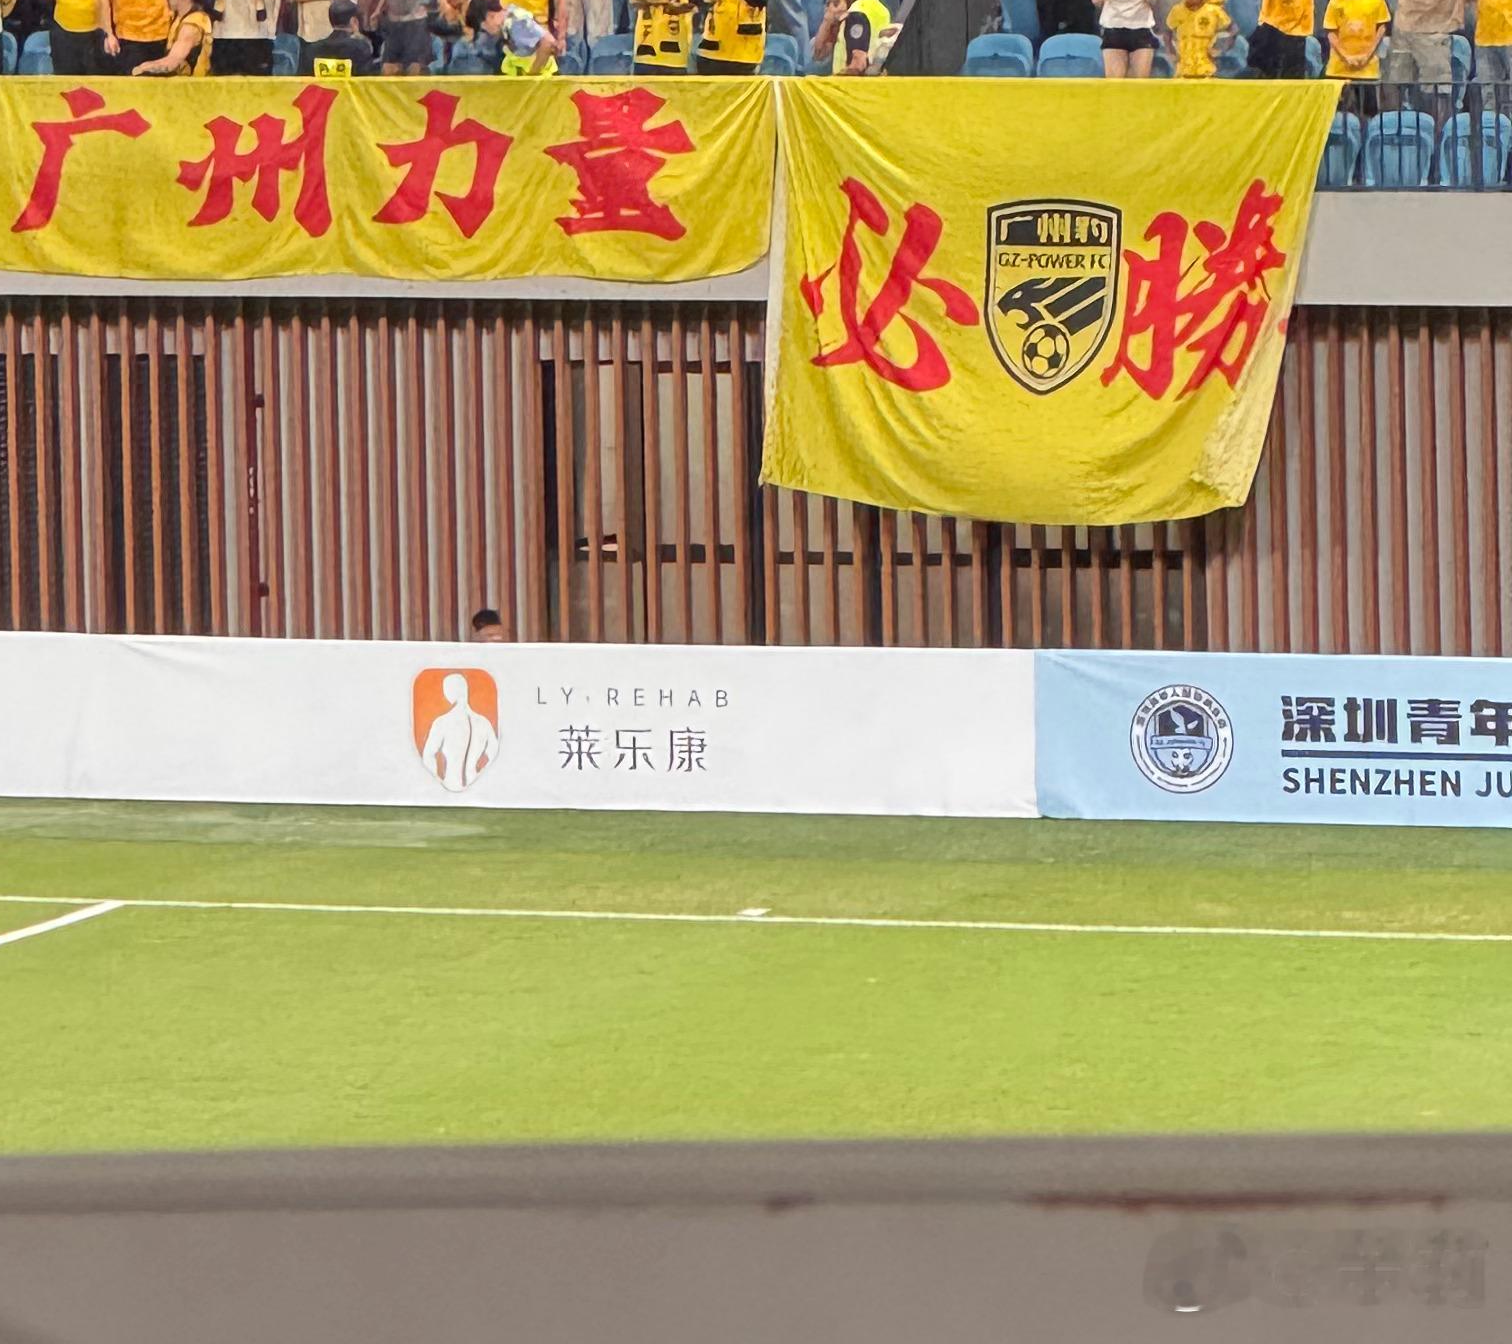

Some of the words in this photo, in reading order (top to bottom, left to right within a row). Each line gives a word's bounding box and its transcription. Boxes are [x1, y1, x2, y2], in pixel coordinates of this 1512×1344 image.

[11, 83, 696, 241] 广州力量
[1280, 695, 1512, 748] 深圳青年
[558, 724, 708, 772] 莱乐康
[1282, 767, 1461, 797] SHENZHEN
[1475, 770, 1512, 798] JU
